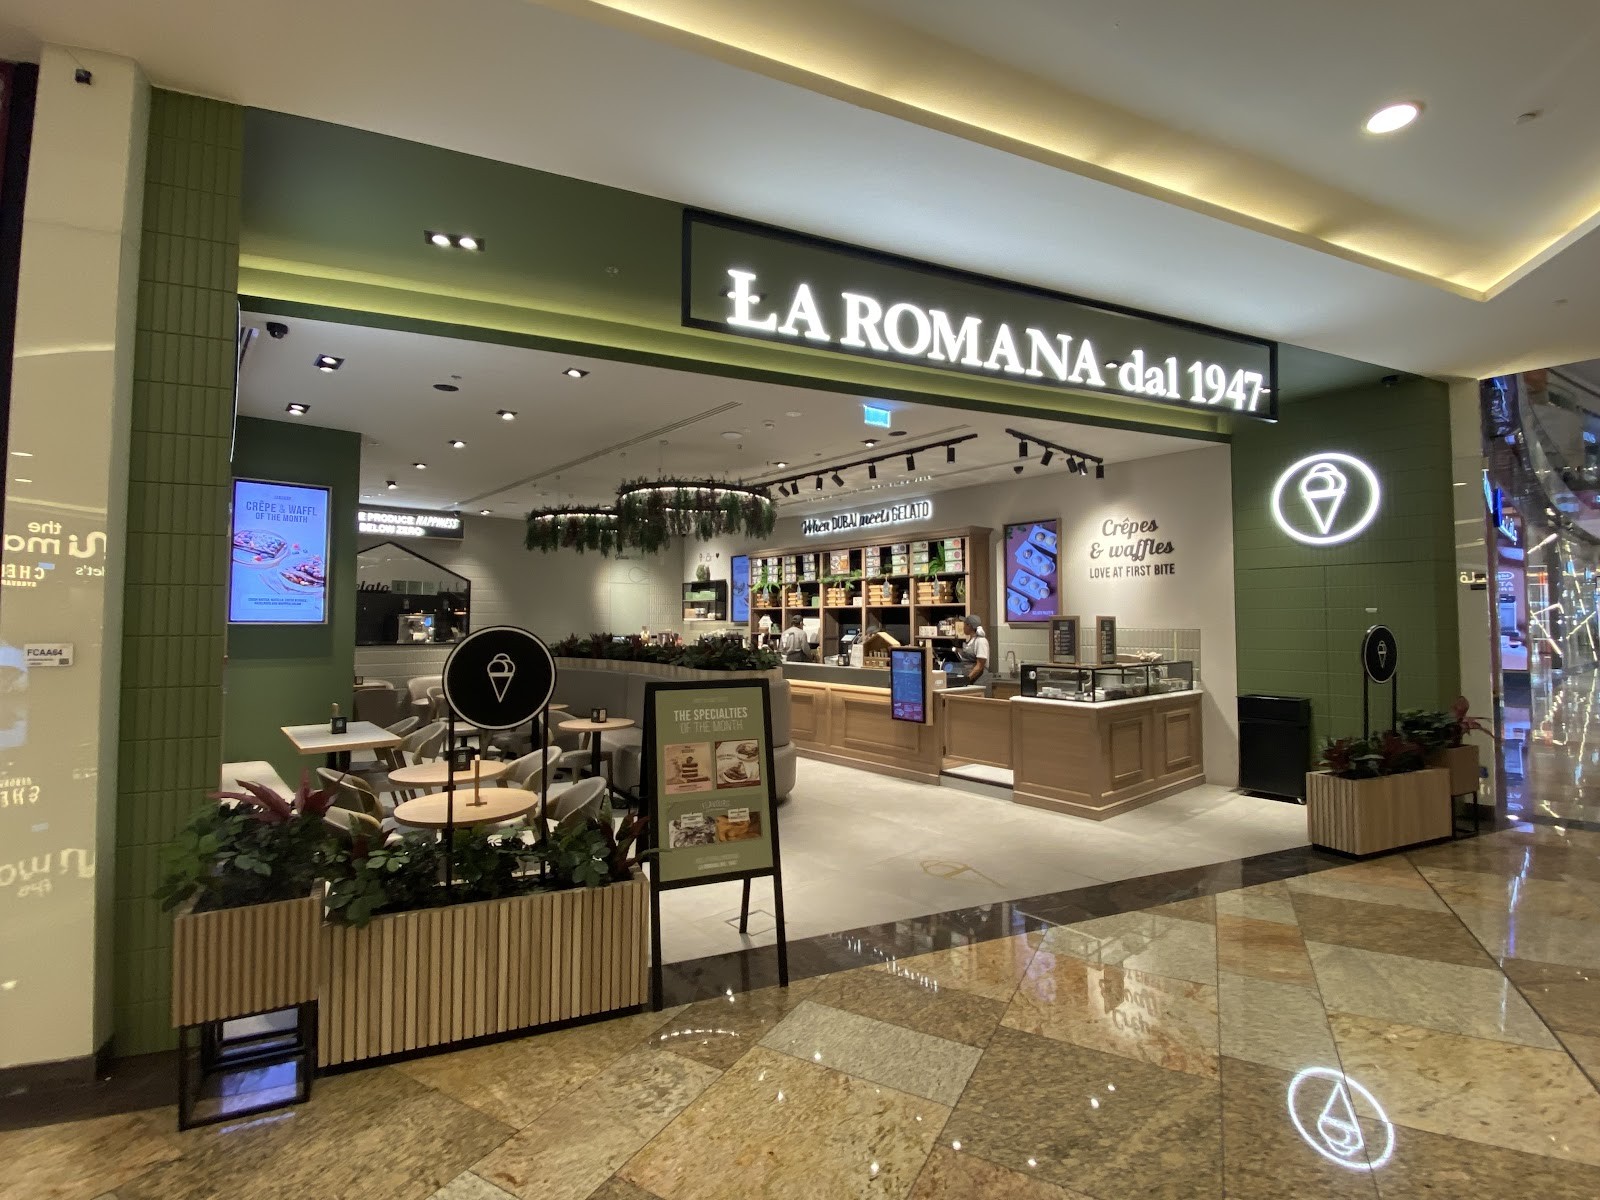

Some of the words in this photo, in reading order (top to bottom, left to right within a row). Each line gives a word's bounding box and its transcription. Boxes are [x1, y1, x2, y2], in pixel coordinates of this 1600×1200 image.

[839, 292, 1104, 387] ROMANA
[1119, 350, 1179, 399] dal
[1188, 361, 1264, 411] 1947
[246, 500, 276, 513] CRÊPE
[279, 505, 286, 514] &
[255, 512, 265, 520] OF
[267, 513, 281, 522] THE
[283, 515, 308, 524] MONTH
[416, 515, 460, 529] HAPPINESS
[801, 519, 831, 535] When
[832, 513, 857, 531] DUBAI
[860, 509, 890, 527] meets
[891, 501, 930, 521] GELATO
[1102, 517, 1158, 539] Crêpes
[1090, 542, 1104, 559] &
[1109, 539, 1175, 562] waffles
[1090, 567, 1111, 579] LOVE
[1113, 566, 1123, 577] AT
[1126, 565, 1152, 577] FIRST
[1154, 563, 1176, 575] BITE
[27, 648, 63, 657] FCAA64
[674, 709, 692, 722] THE
[694, 706, 749, 721] SPECIALTIES
[679, 722, 691, 734] OF
[694, 721, 711, 733] THE
[713, 719, 744, 732] MONTH
